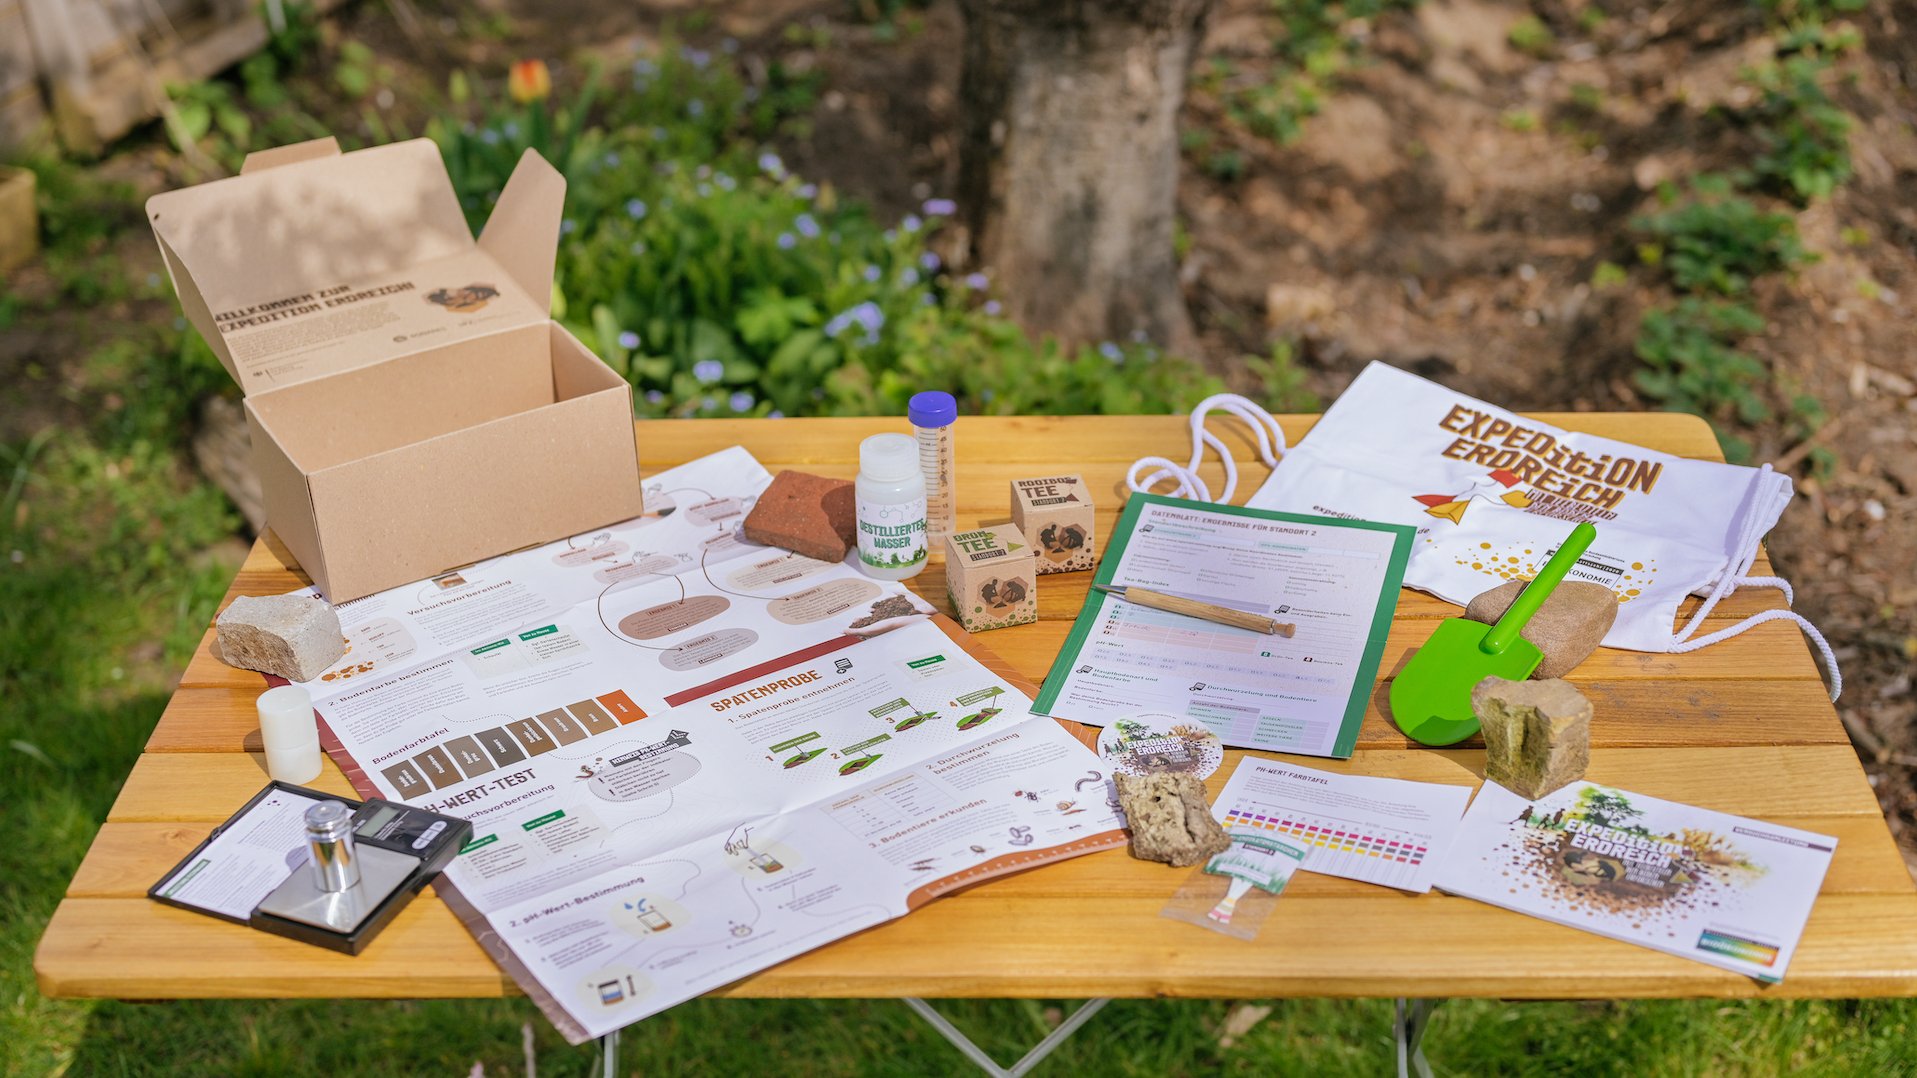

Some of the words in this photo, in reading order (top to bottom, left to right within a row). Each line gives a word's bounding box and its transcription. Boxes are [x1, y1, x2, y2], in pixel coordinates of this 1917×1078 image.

[319, 284, 351, 299] ZUR
[219, 302, 322, 334] EXPEDITION
[1021, 485, 1060, 498] TEE
[1151, 510, 1200, 522] DATENBLATT:
[1202, 518, 1250, 529] ERGEBNISSE
[1270, 526, 1309, 536] STANDORT
[874, 537, 911, 549] WASSER
[957, 538, 998, 553] TEE
[408, 580, 512, 616] Versuchsvorbereitung
[340, 678, 397, 703] Bodenfarbe
[399, 659, 454, 681] bestimmen
[709, 669, 822, 713] SPATENPROBE
[1207, 685, 1263, 697] Durchwurzelung
[738, 697, 800, 721] Spatenprobe
[801, 677, 856, 700] entnehmen
[373, 727, 450, 765] Bodenfarbtafel
[933, 750, 990, 775] bestimmen
[937, 732, 1020, 766] Durchwurzelung
[424, 768, 537, 813] H-WERT-TEST
[1256, 766, 1287, 777] PH-WERT
[1288, 772, 1329, 785] FARBTAFEL
[463, 784, 555, 820] uchsvorbereitung
[880, 818, 937, 843] Bodentiere
[939, 798, 987, 819] erkunden
